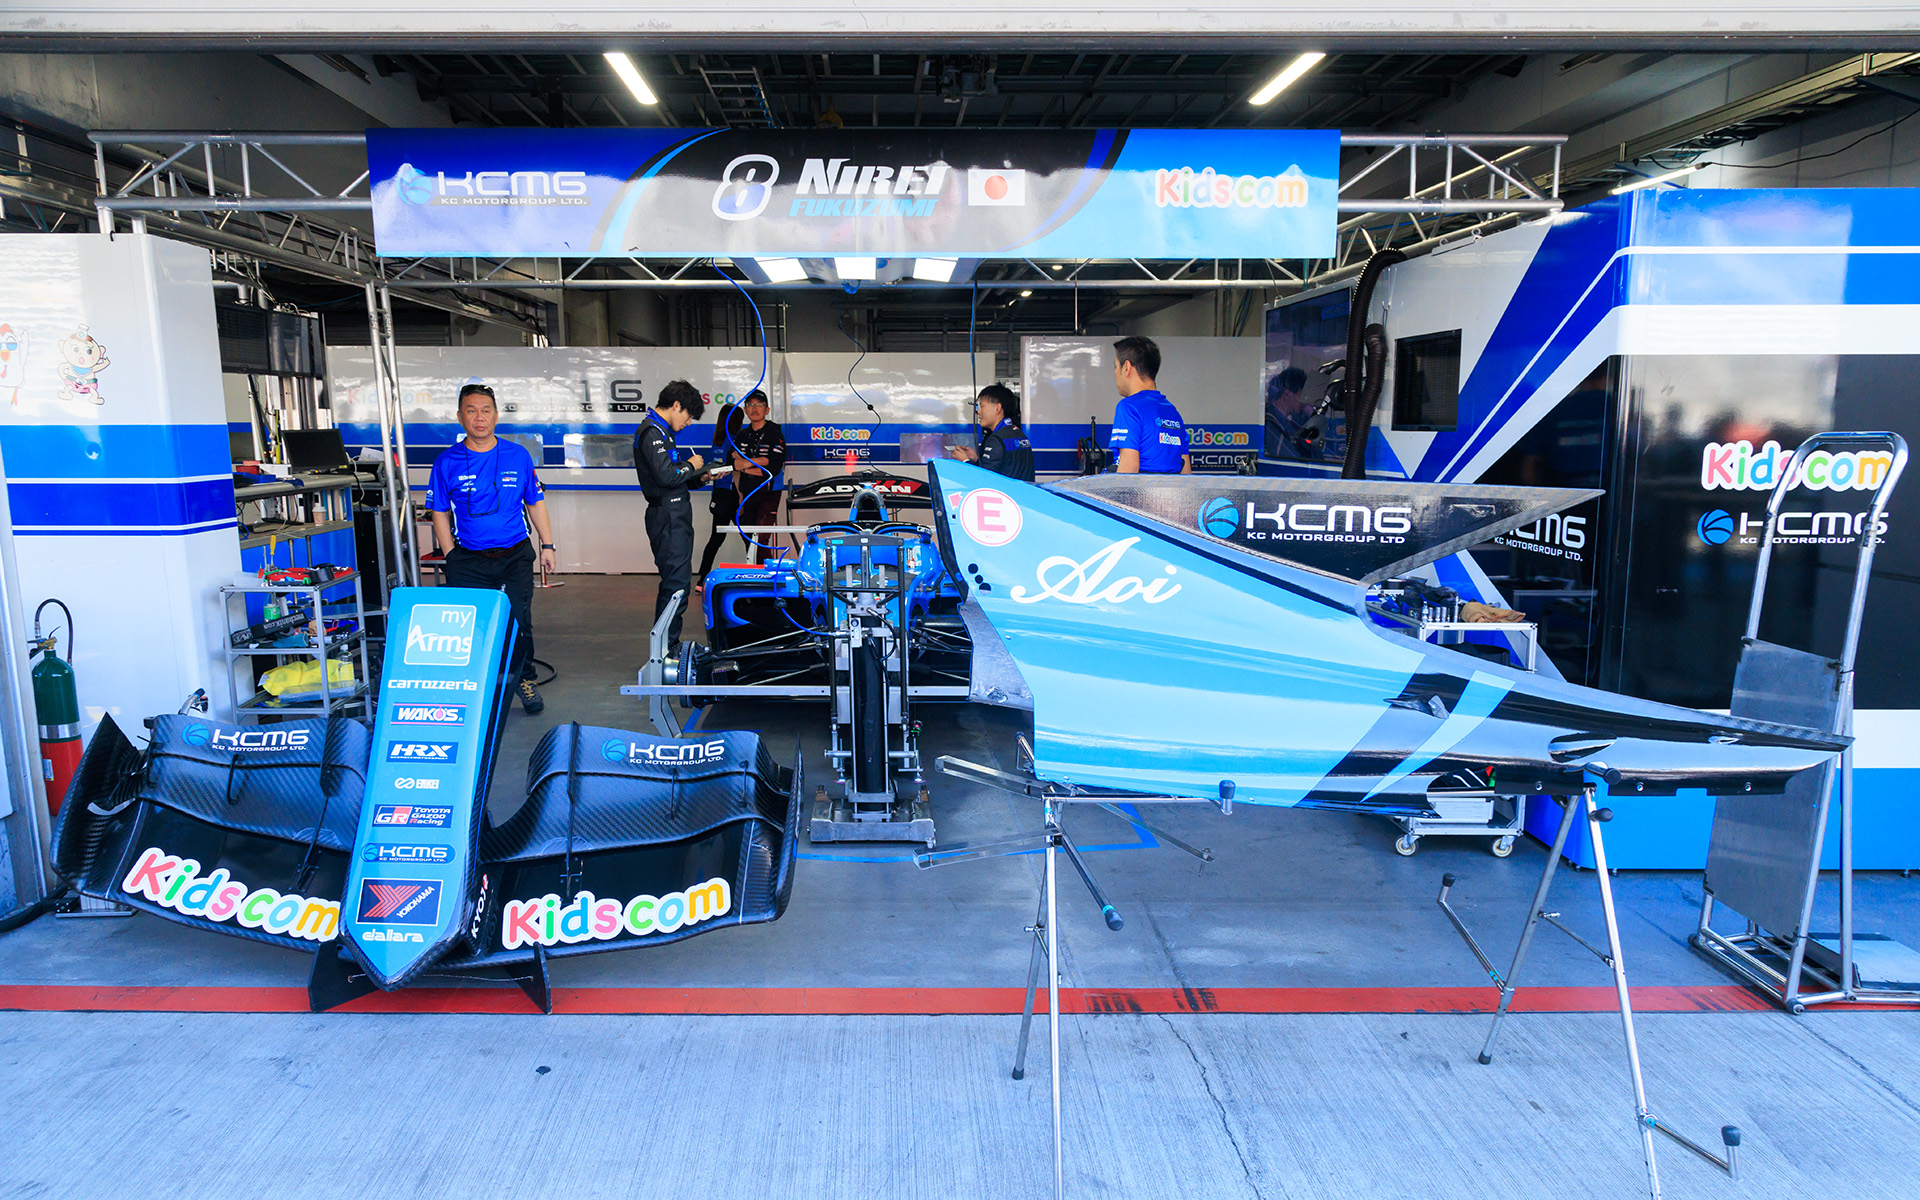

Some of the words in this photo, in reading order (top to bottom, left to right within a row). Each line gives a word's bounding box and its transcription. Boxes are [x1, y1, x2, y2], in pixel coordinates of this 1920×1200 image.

[437, 171, 587, 196] KCMG
[712, 153, 780, 221] 8
[795, 158, 953, 195] NIREI
[441, 197, 458, 205] KC
[462, 197, 556, 205] MOTORGROUP
[561, 197, 587, 205] LTD.
[789, 199, 942, 217] FUKUZUMI
[1188, 429, 1247, 444] idscom
[824, 448, 870, 456] KCMG
[976, 495, 1006, 532] E
[1245, 502, 1412, 534] KCMG
[1246, 532, 1267, 540] KC
[1271, 533, 1376, 543] MOTORGROUP
[1380, 536, 1406, 544] LTD
[1493, 536, 1504, 545] KC
[1505, 538, 1563, 557] MOTORGROUP
[1564, 550, 1584, 562] LTD.
[1010, 536, 1182, 604] Aoi
[441, 610, 472, 628] my
[407, 625, 472, 652] Arms
[387, 679, 478, 691] carrozzeria
[212, 729, 310, 746] KCMG
[390, 744, 453, 758] HRX
[629, 739, 725, 760] KCMG
[644, 758, 706, 766] MOTORGROUP
[376, 812, 408, 825] GR
[409, 818, 444, 826] Racing
[379, 846, 448, 858] KCMG
[396, 886, 435, 918] YOKOHAMA
[362, 928, 424, 942] dallara
